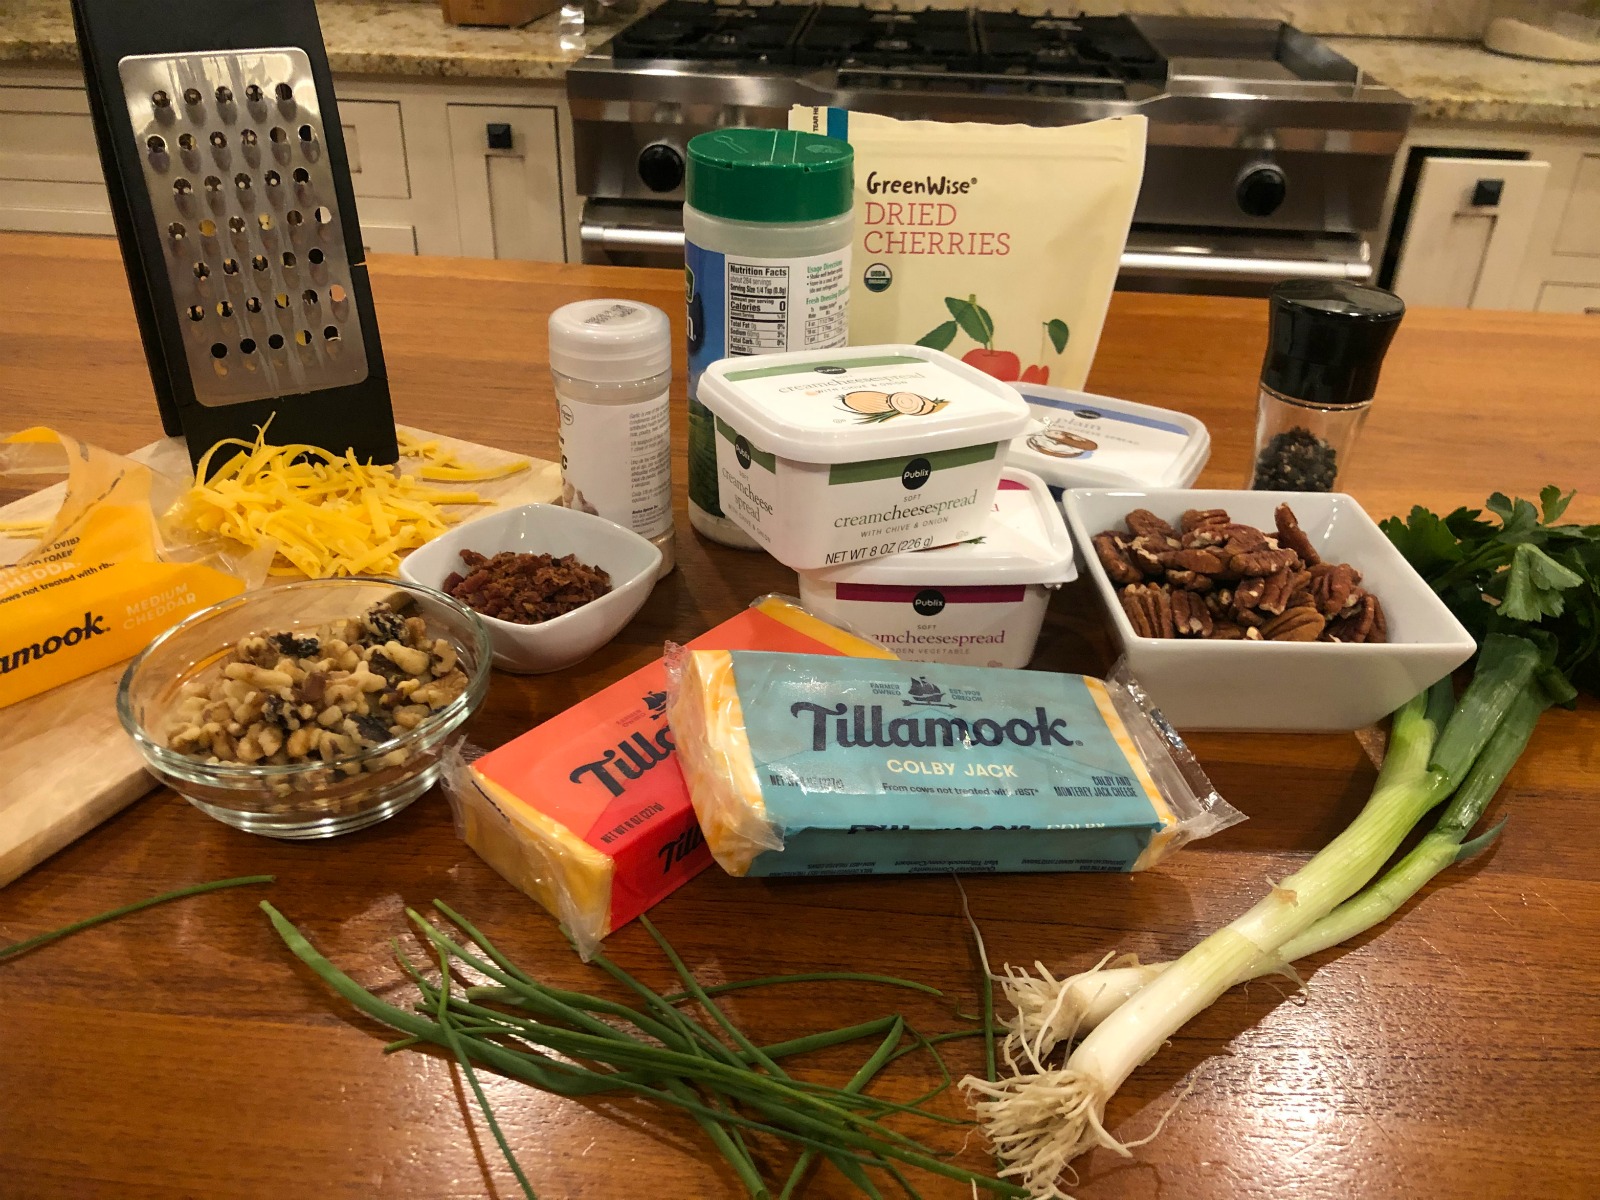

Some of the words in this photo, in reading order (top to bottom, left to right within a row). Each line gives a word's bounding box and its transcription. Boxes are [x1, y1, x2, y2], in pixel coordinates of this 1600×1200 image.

[864, 201, 957, 226] DRIED
[864, 230, 1010, 256] CHERRIES
[730, 264, 764, 276] Nutrition
[765, 268, 787, 276] Facts
[730, 283, 746, 294] Serving
[746, 285, 756, 294] Size
[730, 301, 762, 312] Calories
[779, 300, 786, 312] 0
[730, 320, 742, 328] Total
[778, 372, 928, 394] creamcheesespread
[736, 444, 750, 461] Publix
[903, 468, 930, 480] Publix
[722, 467, 774, 516] creamcheese
[903, 494, 922, 502] SOFT
[734, 494, 760, 522] spread
[834, 489, 978, 528] creamcheesespread
[860, 528, 882, 538] WITH
[886, 524, 910, 534] CHIVE
[922, 516, 949, 528] ONION
[825, 551, 848, 565] NET
[850, 548, 868, 561] WT
[870, 546, 878, 556] 8
[880, 542, 897, 556] OZ
[898, 538, 922, 554] (226
[923, 536, 934, 550] g)
[0, 562, 81, 594] CHEDDA
[22, 586, 40, 597] not
[40, 574, 76, 590] treated
[76, 566, 98, 578] with
[126, 582, 188, 616] MEDIUM
[123, 592, 196, 630] CHEDDAR
[870, 682, 900, 690] FARMER
[886, 759, 955, 776] COLBY
[964, 763, 1018, 778] JACK
[882, 782, 908, 792] From
[938, 786, 954, 794] not
[954, 787, 990, 796] treated
[1054, 786, 1092, 797] MONTEREY
[1094, 786, 1112, 797] JACK
[1112, 786, 1138, 798] CHEESE
[1092, 776, 1116, 786] COLBY
[1117, 776, 1132, 786] AND
[600, 831, 618, 844] NET
[612, 824, 629, 836] WT
[630, 814, 644, 826] OZ
